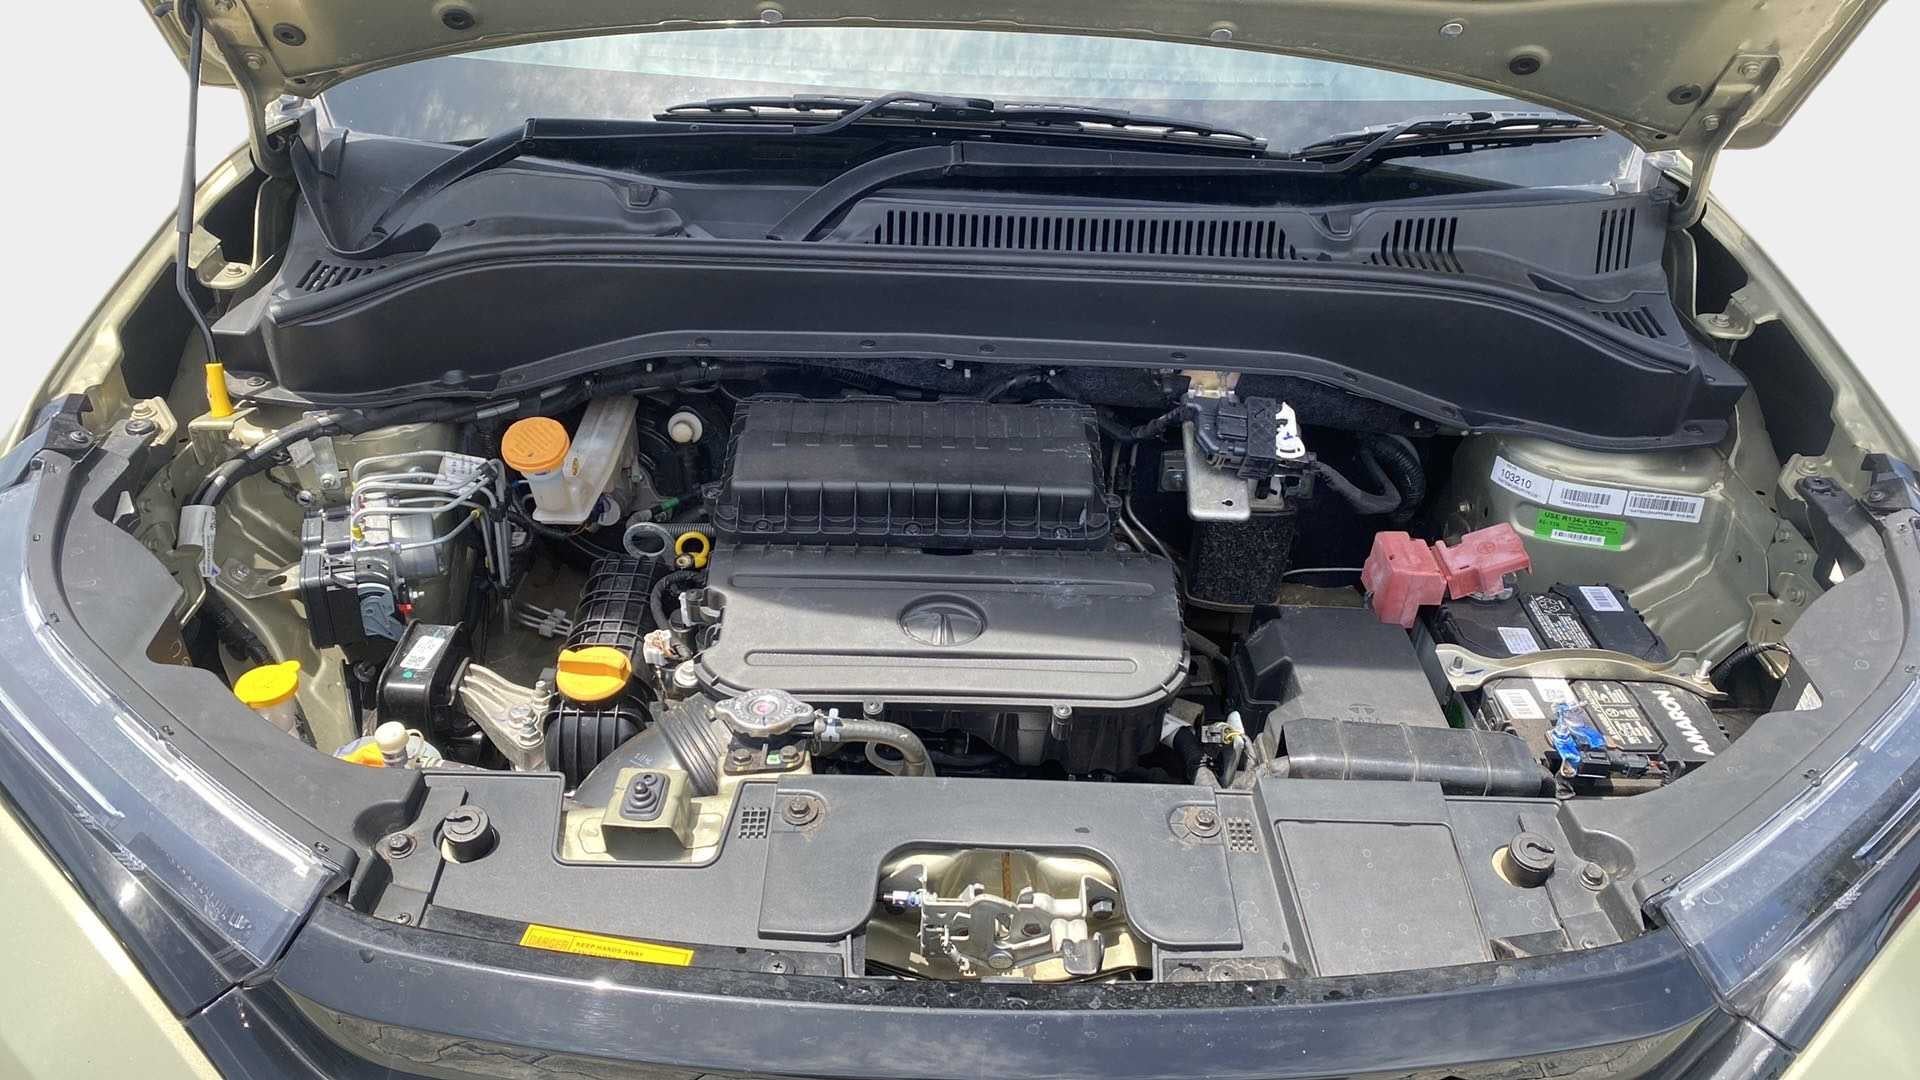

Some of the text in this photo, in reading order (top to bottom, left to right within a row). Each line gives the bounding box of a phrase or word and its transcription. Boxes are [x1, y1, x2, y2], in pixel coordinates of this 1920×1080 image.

[1501, 469, 1532, 489] 103210
[1544, 512, 1560, 520] USE
[1589, 518, 1610, 526] ONLY
[1652, 689, 1715, 756] AMARON
[597, 945, 621, 953] HANDS
